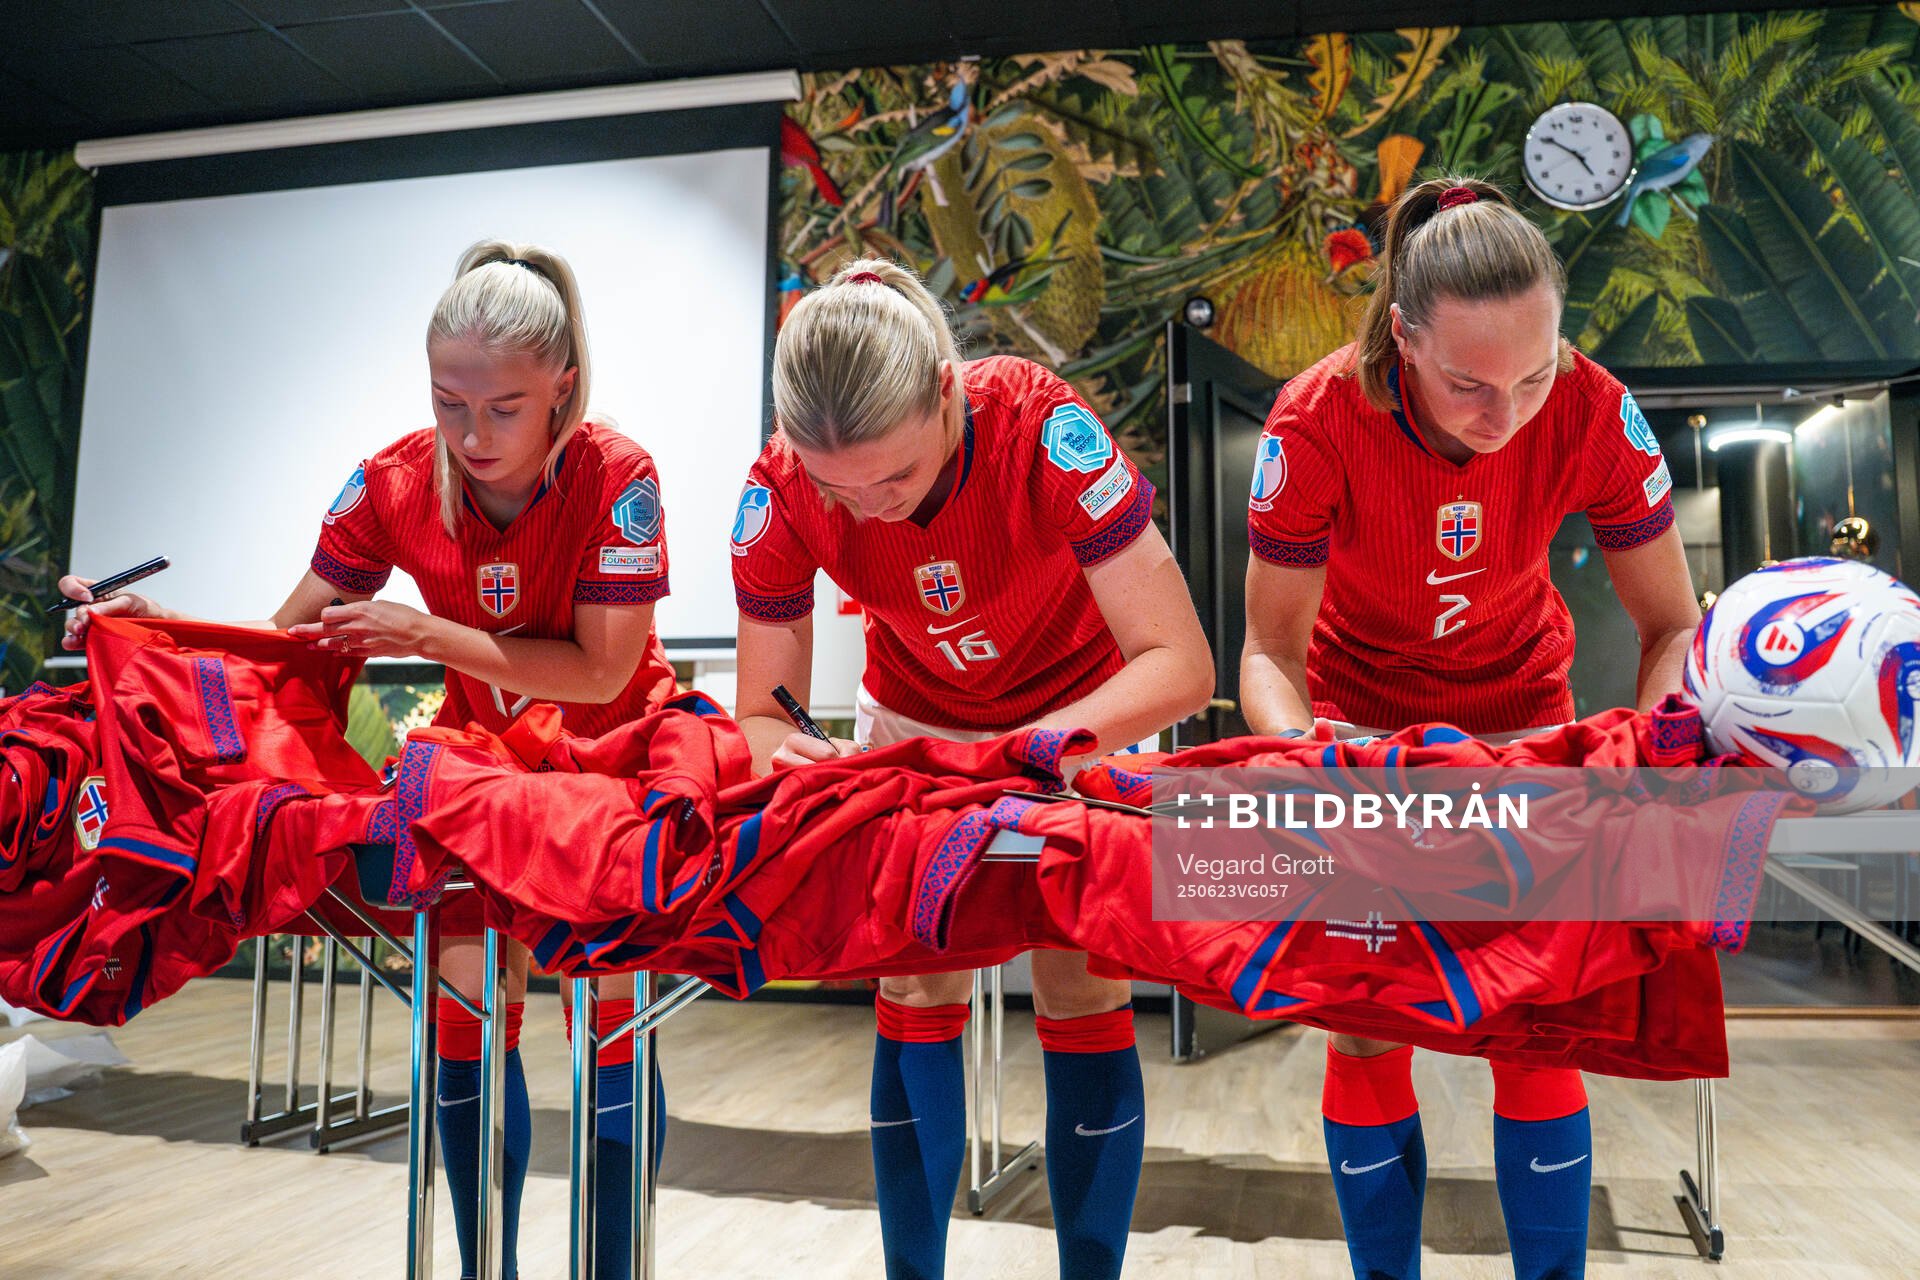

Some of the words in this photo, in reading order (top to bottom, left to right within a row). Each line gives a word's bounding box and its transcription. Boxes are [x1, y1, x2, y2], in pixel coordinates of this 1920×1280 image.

[1076, 432, 1097, 453] Strong
[1086, 470, 1127, 511] FOUNDATION
[601, 556, 655, 565] FOUNDATION
[1433, 594, 1471, 640] 2
[934, 630, 1000, 671] 16
